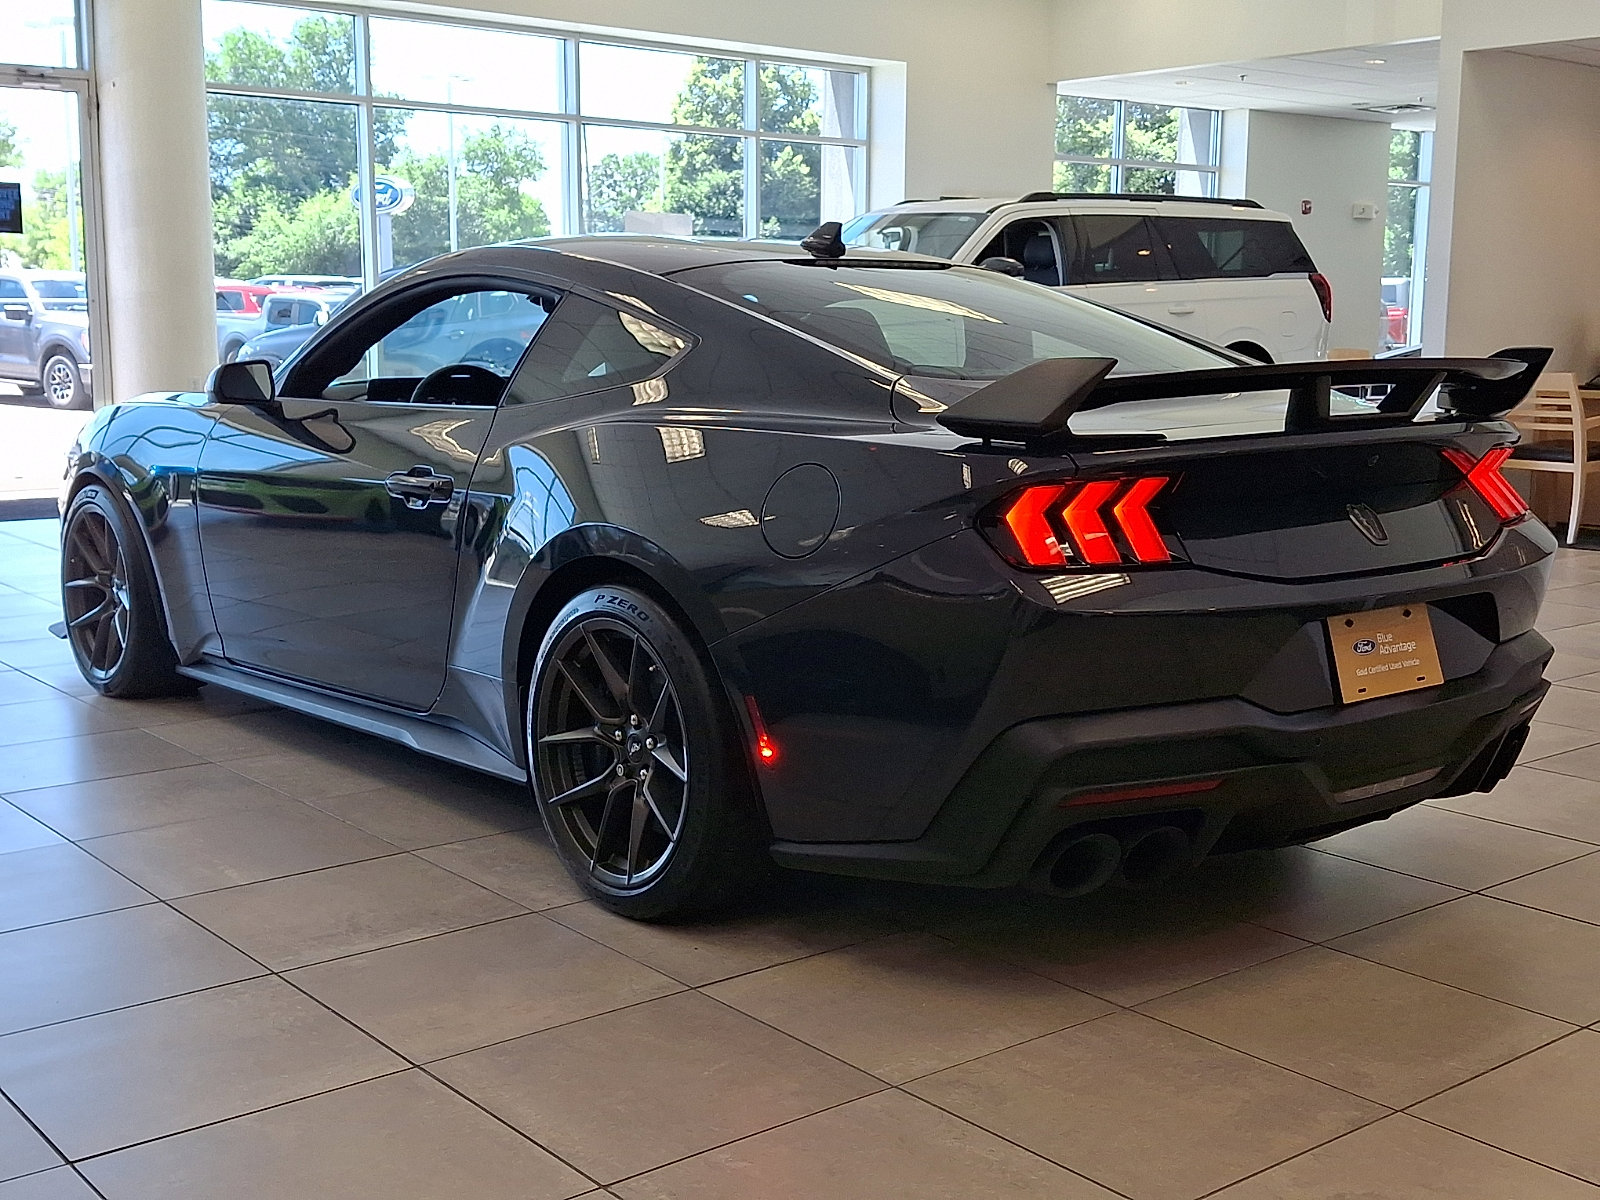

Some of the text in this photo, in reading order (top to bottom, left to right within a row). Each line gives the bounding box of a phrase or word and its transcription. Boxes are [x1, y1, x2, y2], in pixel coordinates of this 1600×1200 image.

[594, 594, 650, 621] P ZERO
[1376, 633, 1393, 643] Blue
[1356, 640, 1373, 653] Ford
[1379, 641, 1417, 655] Advantage
[1368, 664, 1389, 674] Certified
[1402, 658, 1420, 667] Vehicle
